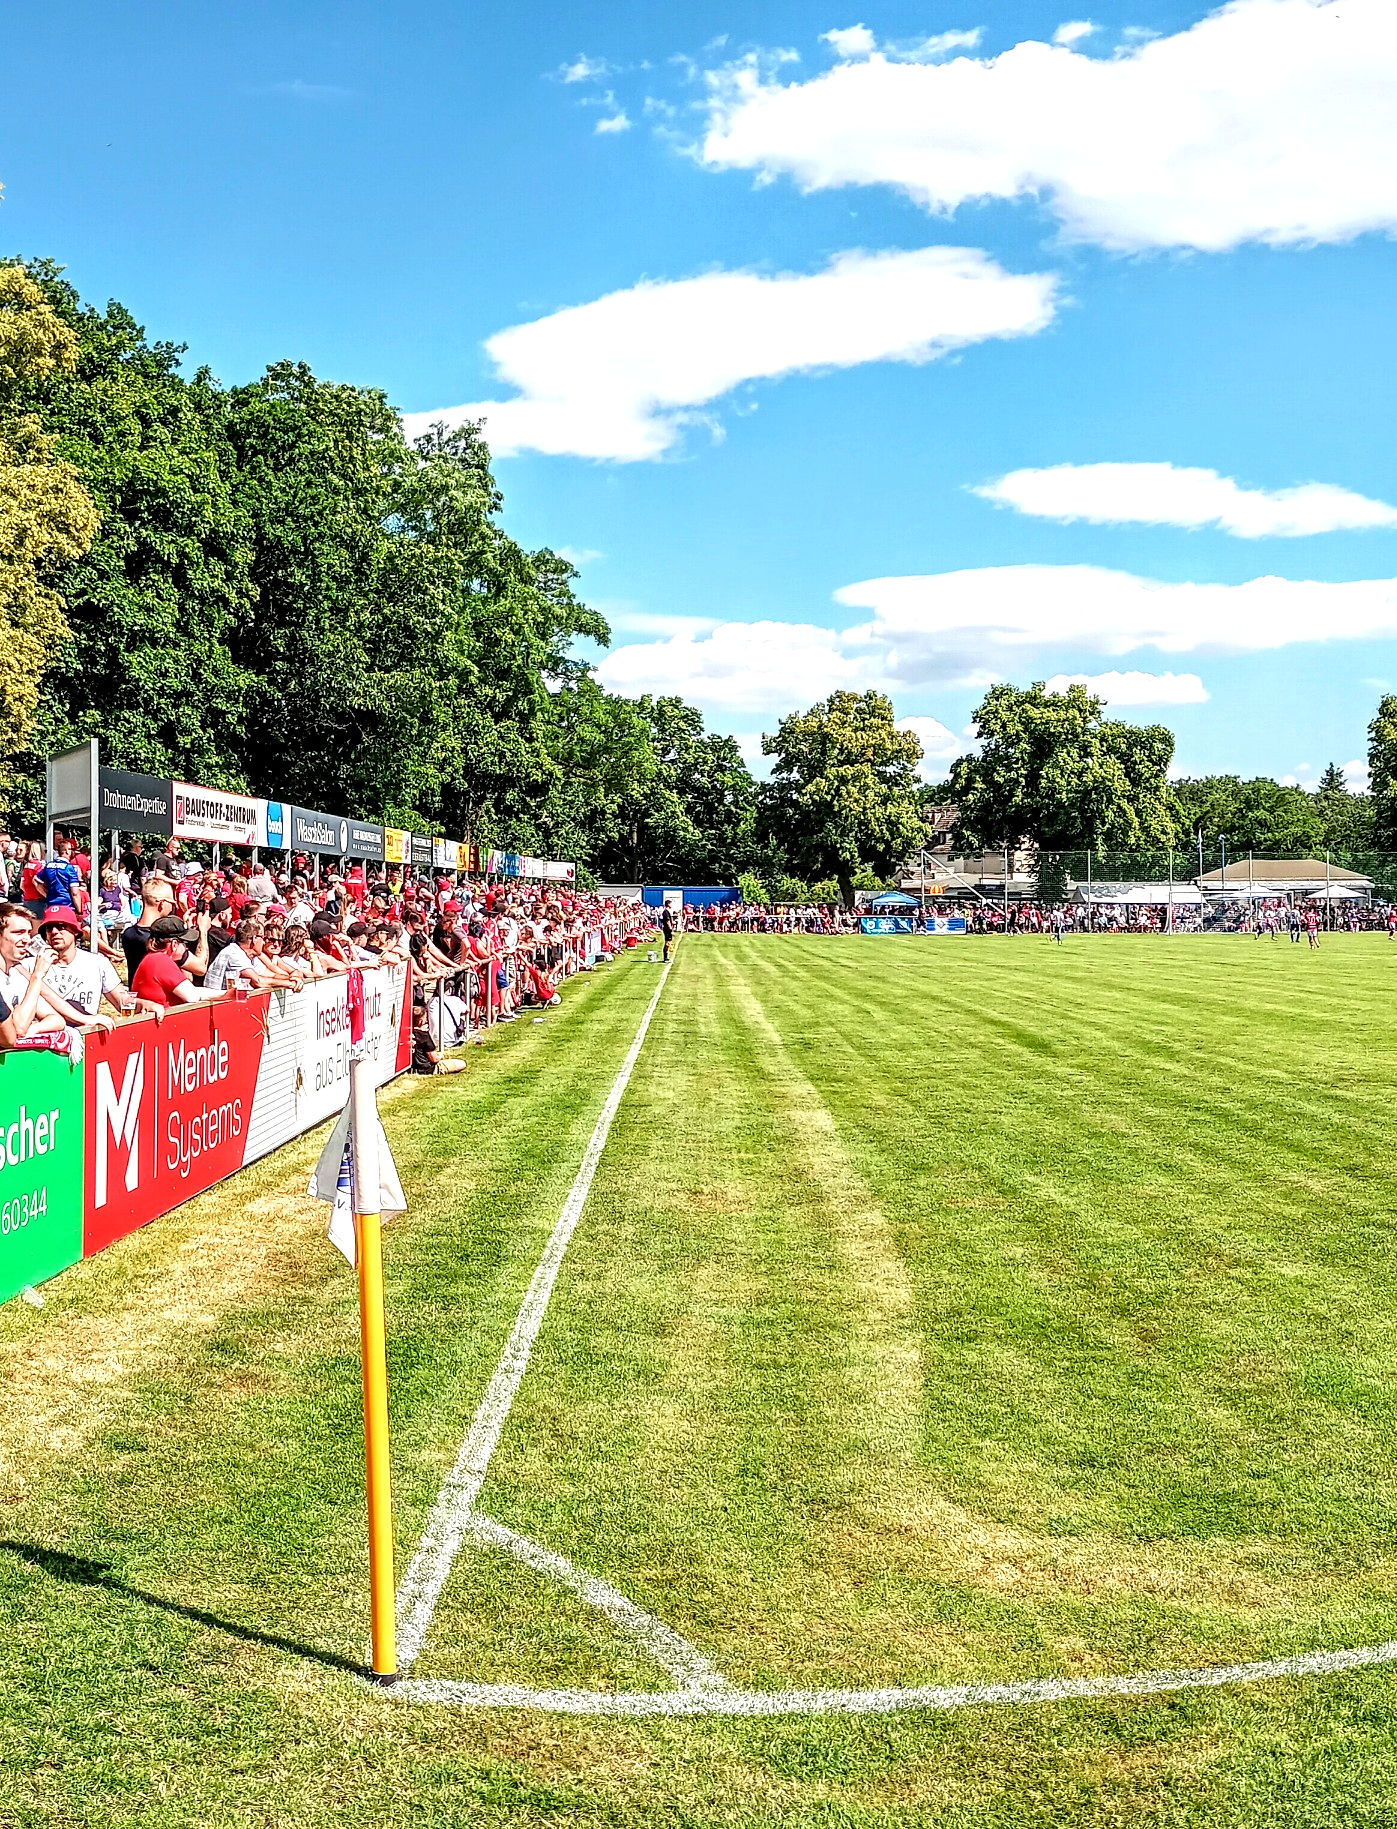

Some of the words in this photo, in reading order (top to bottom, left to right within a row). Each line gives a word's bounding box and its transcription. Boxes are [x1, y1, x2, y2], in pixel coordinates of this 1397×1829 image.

[104, 788, 167, 817] DrohnenExpertise
[185, 796, 257, 826] BAUSTOFF-ZENTRUM
[296, 817, 336, 846] WaschSalon
[316, 986, 382, 1041] Insektehutz
[167, 1029, 229, 1100] Mende
[315, 1056, 334, 1092] aus
[166, 1098, 242, 1179] Systems
[1, 1186, 48, 1236] 60344
